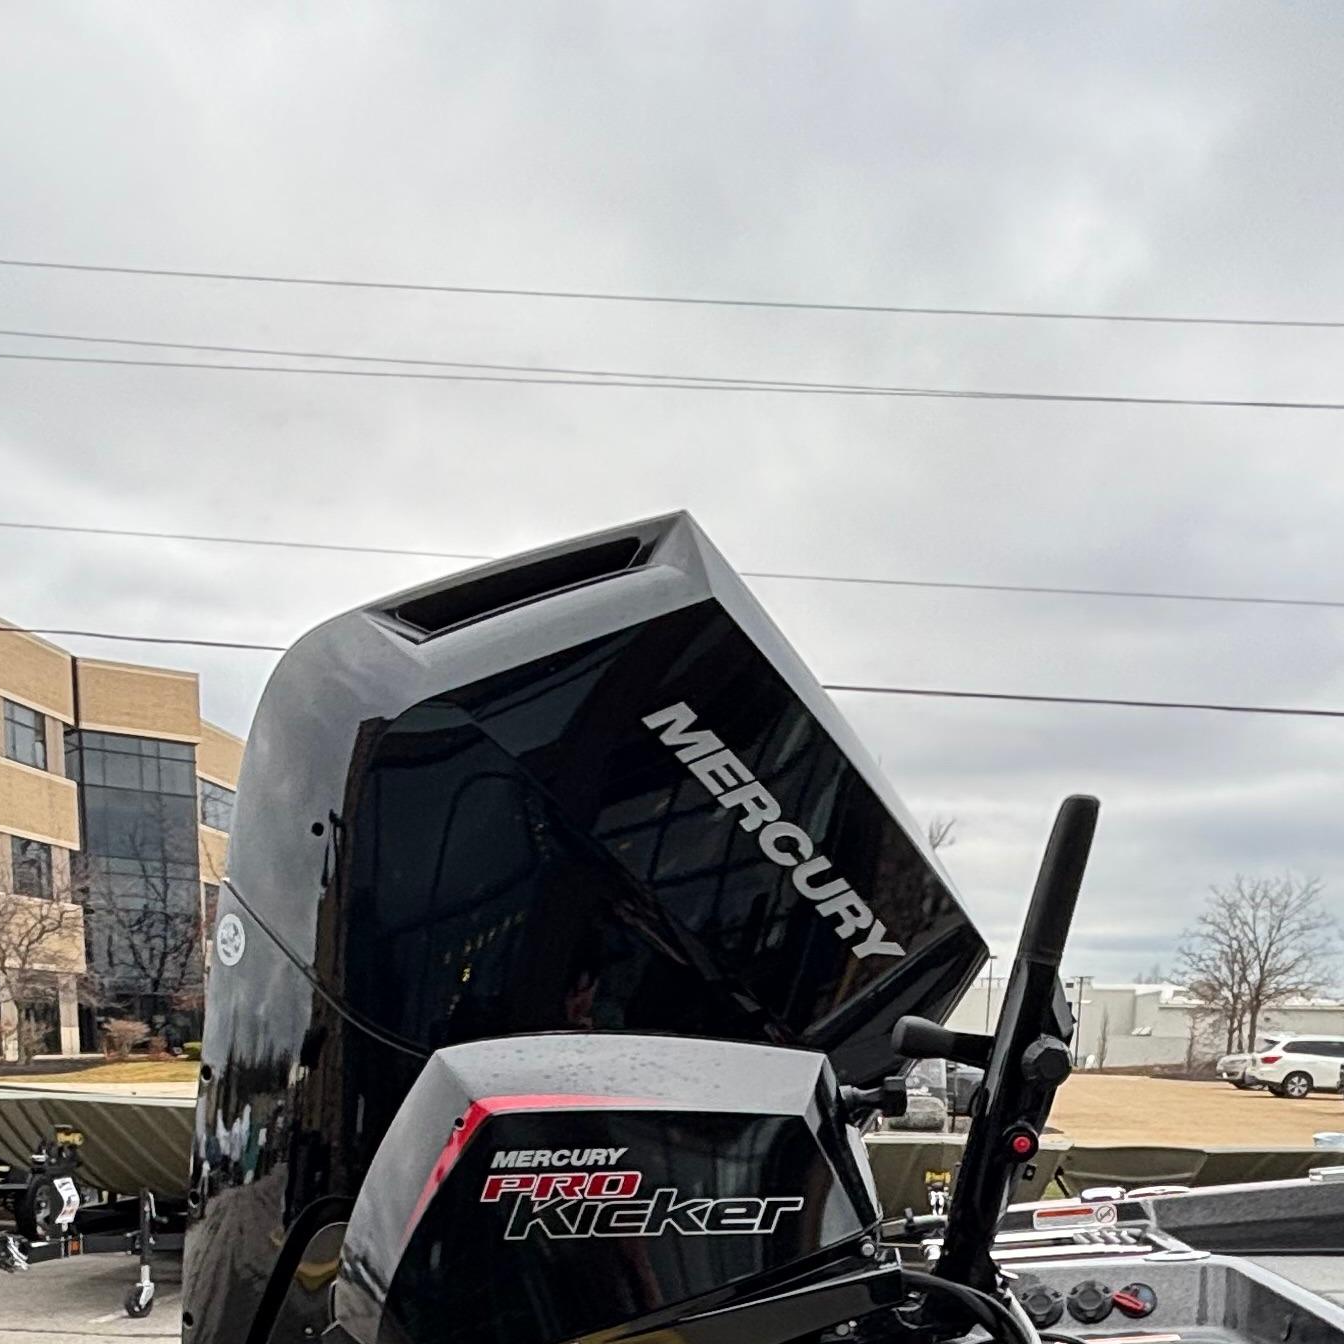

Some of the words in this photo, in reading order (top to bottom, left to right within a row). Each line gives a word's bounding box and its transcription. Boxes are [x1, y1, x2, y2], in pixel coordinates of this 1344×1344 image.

[641, 701, 906, 959] MERCURY
[490, 1147, 629, 1168] MERCURY
[480, 1171, 642, 1202] PRO
